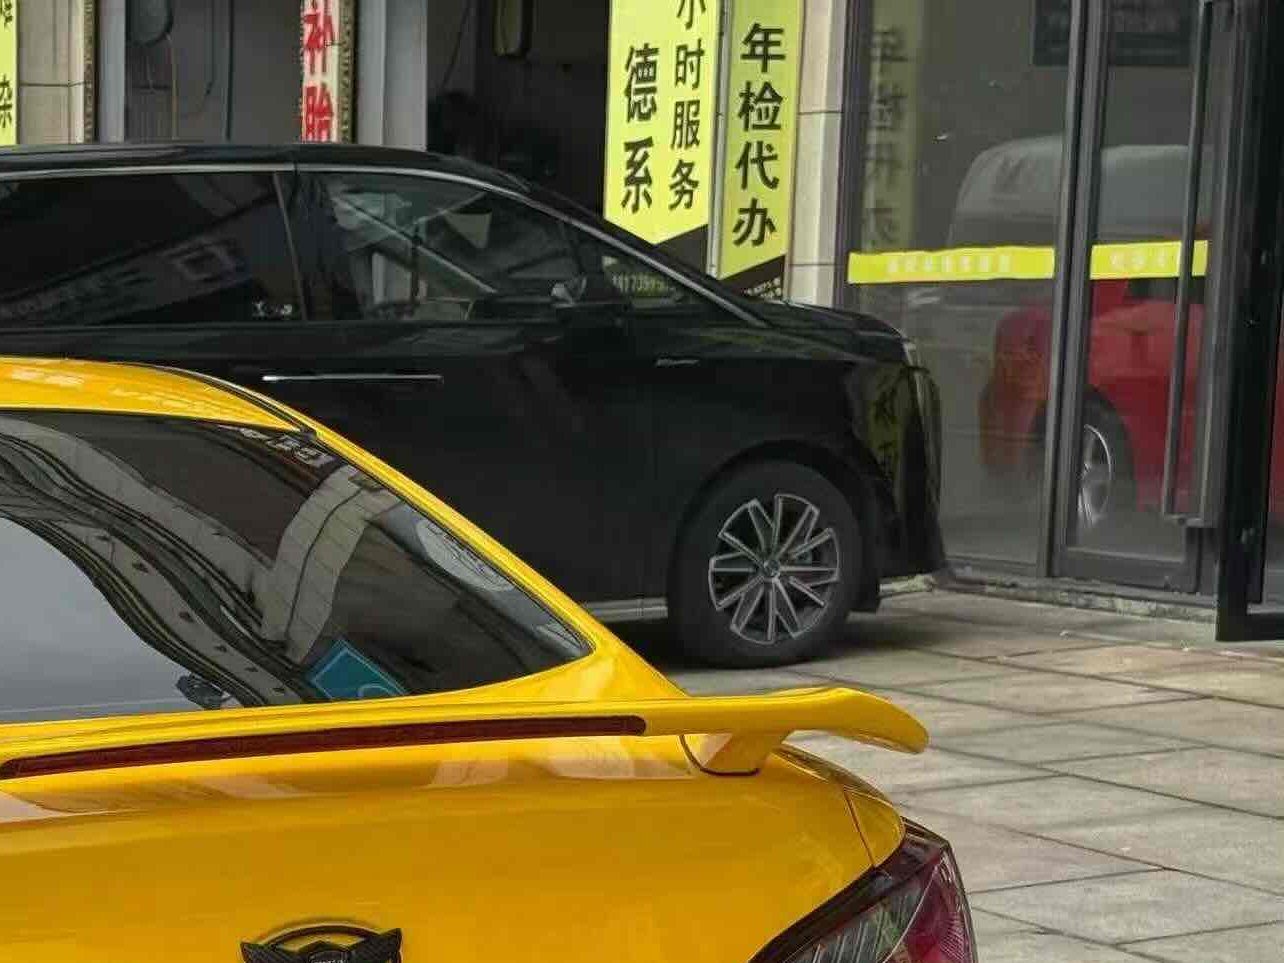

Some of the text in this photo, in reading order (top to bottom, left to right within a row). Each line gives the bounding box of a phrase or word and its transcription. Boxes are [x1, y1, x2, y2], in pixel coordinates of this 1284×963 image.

[621, 43, 659, 213] 德系
[669, 0, 706, 211] 小时服务
[732, 23, 786, 247] 年检代办
